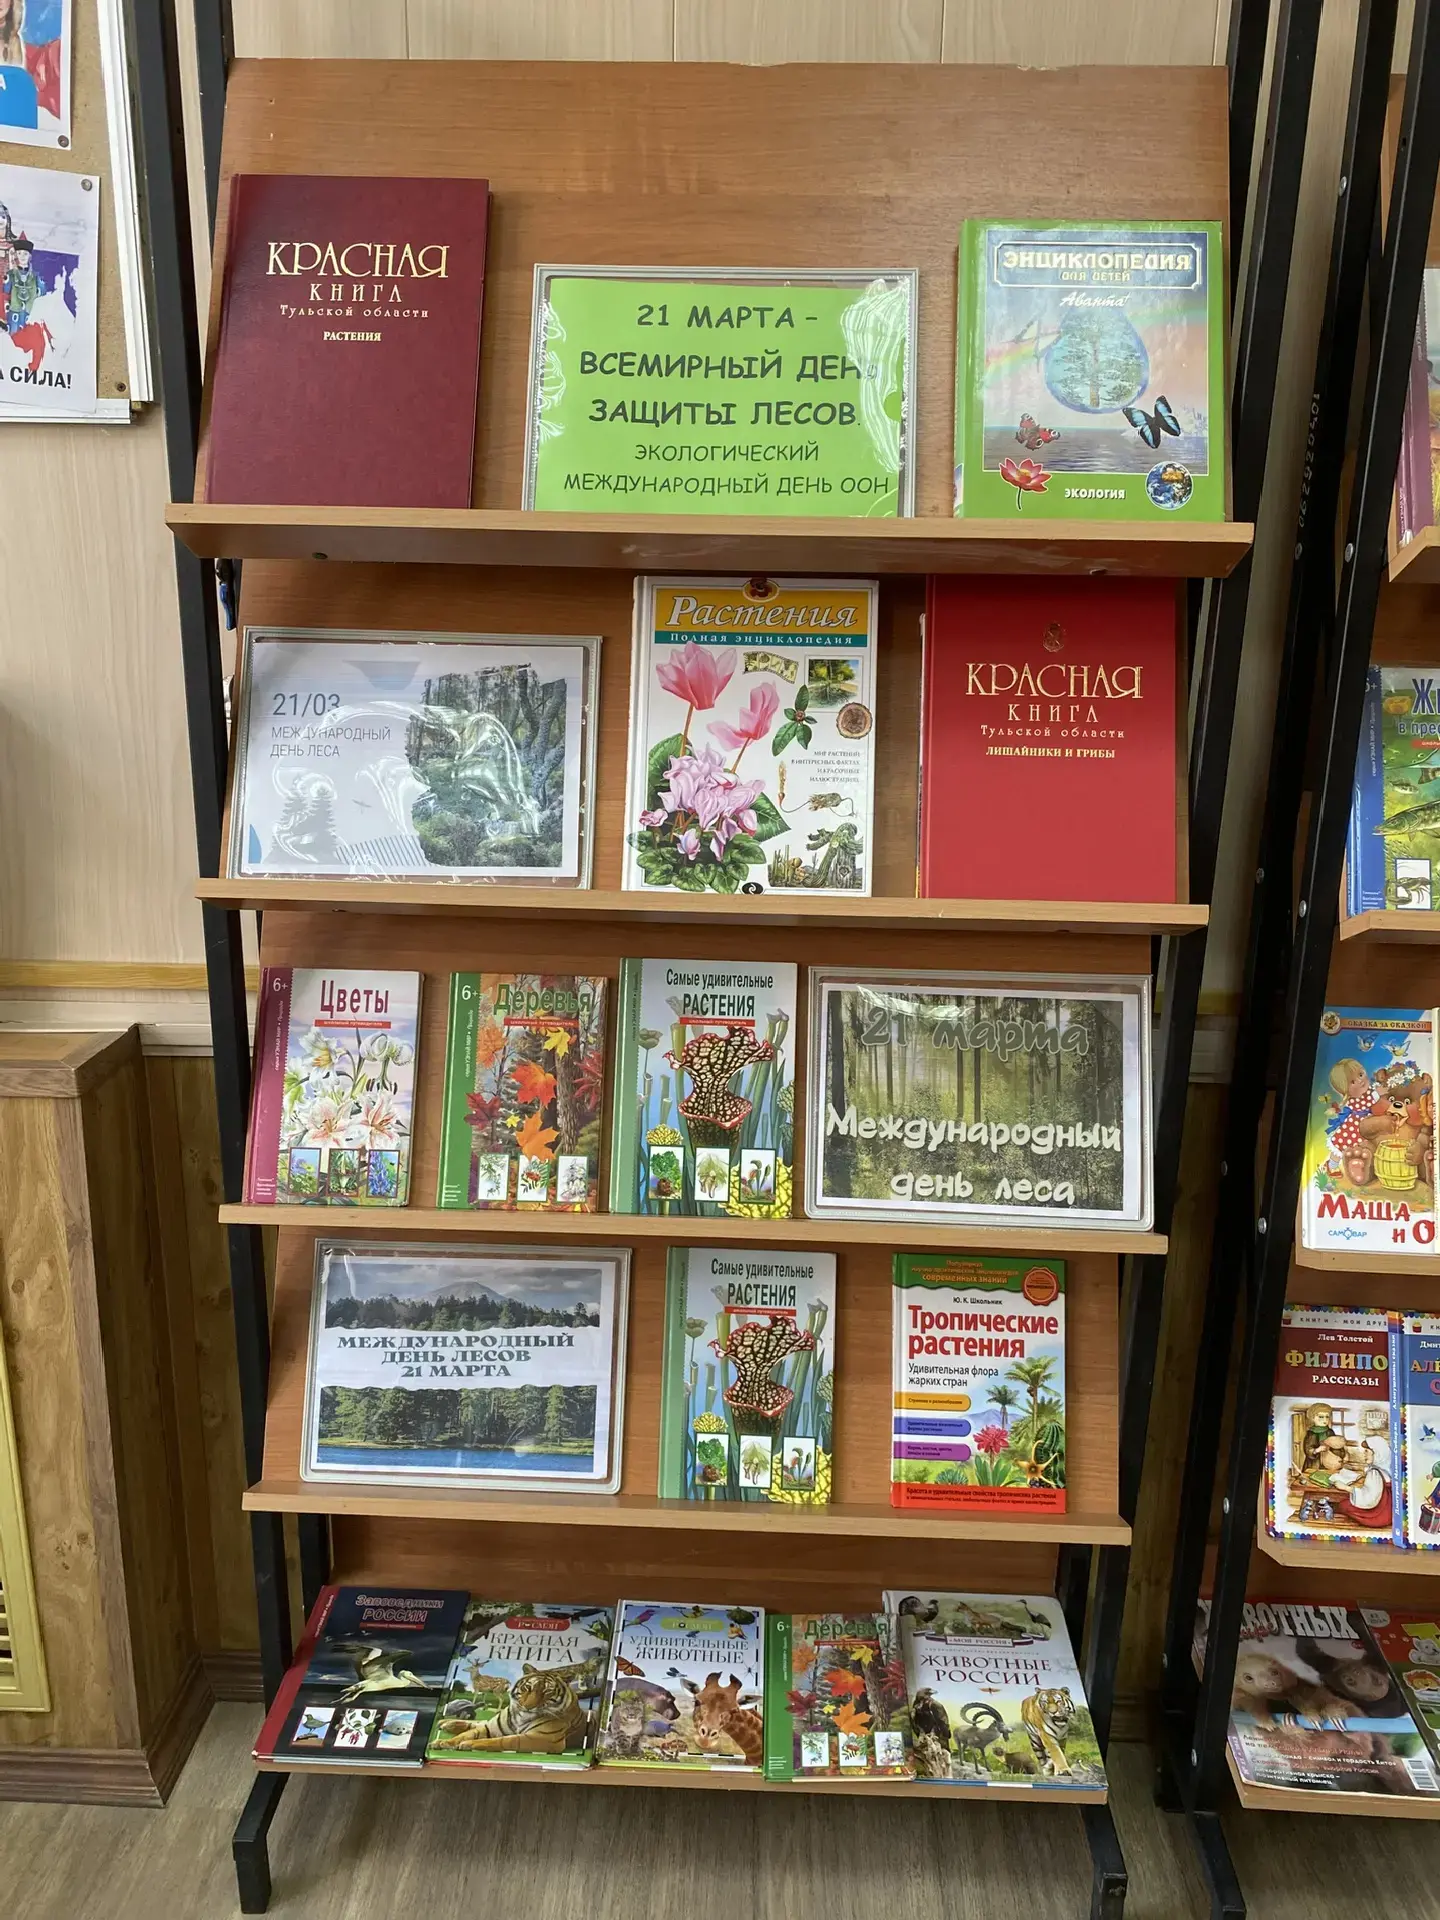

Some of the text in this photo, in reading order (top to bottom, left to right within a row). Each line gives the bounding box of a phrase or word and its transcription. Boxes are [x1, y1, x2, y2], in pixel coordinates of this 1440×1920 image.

[266, 242, 450, 279] КРАСНАЯ
[1003, 250, 1192, 271] ЭНЦИКЛОПЕДИЯ
[309, 283, 403, 304] КНИГА
[280, 304, 430, 319] Тульской области
[636, 304, 670, 328] 21
[687, 304, 795, 329] МАРТА
[323, 330, 382, 343] РАСТЕНИЯ
[579, 349, 784, 381] ВСЕМИРНЫЙ
[9, 366, 72, 389] СИЛА!
[588, 399, 861, 428] ЗАЩИТЫ ЛЕСОВ.
[634, 441, 820, 462] ЭКОЛОГИЧЕСКИЙ
[563, 473, 889, 497] МЕЖДУНАРОДНЫЙ ДЕНЬ ООН
[1064, 487, 1127, 500] ЭКОЛОГИЯ
[665, 595, 858, 629] Растения
[670, 632, 853, 645] Полная энциклопедия
[965, 662, 1144, 699] КРАСНАЯ
[271, 692, 341, 718] 21/03
[1008, 703, 1099, 724] КНИГА
[271, 723, 392, 741] МЕЖДУНАРОДНЫЙ
[981, 724, 1125, 739] Тульской области
[269, 744, 340, 759] ДЕНЬ ЛЕСА
[986, 745, 1115, 759] ЛИШАЙНИКИ И ГРИБЫ
[273, 977, 289, 992] 6+
[666, 968, 774, 990] Самые удивительные
[320, 979, 390, 1018] Цветы
[461, 984, 479, 1001] 6+
[493, 983, 591, 1016] Деревья
[682, 993, 755, 1017] РАСТЕНИЯ
[861, 1006, 1090, 1062] 21 марта
[825, 1102, 1122, 1155] Международный
[889, 1171, 1076, 1206] день леса
[711, 1258, 814, 1280] Самые удивительные
[727, 1282, 796, 1307] РАСТЕНИЯ
[970, 1297, 1003, 1305] Школьник
[908, 1304, 1059, 1335] Тропические
[337, 1332, 575, 1350] МЕЖДУНАРОДНЫЙ
[908, 1334, 1025, 1360] растения
[1318, 1333, 1374, 1343] Лев Толстой
[381, 1350, 532, 1365] ДЕНЬ ЛЕСОВ
[401, 1365, 511, 1378] 21 МАРТА
[908, 1362, 999, 1378] Удивительная флора
[908, 1376, 968, 1388] жарких стран
[1312, 1375, 1380, 1387] РАССКАЗЫ
[355, 1594, 445, 1609] Заповедники
[362, 1608, 428, 1622] РОССИИ
[1243, 1602, 1360, 1640] ВОТНЫХ
[776, 1621, 791, 1632] 6+
[804, 1619, 889, 1640] Деревья
[490, 1632, 579, 1648] КРАСНАЯ
[629, 1635, 749, 1651] УДИВИТЕЛЬНЫЕ
[488, 1645, 575, 1663] КНИГА
[635, 1646, 744, 1664] ЖИВОТНЫЕ
[920, 1654, 1052, 1672] ЖИВОТНЫЕ
[933, 1669, 1041, 1686] РОССИИ
